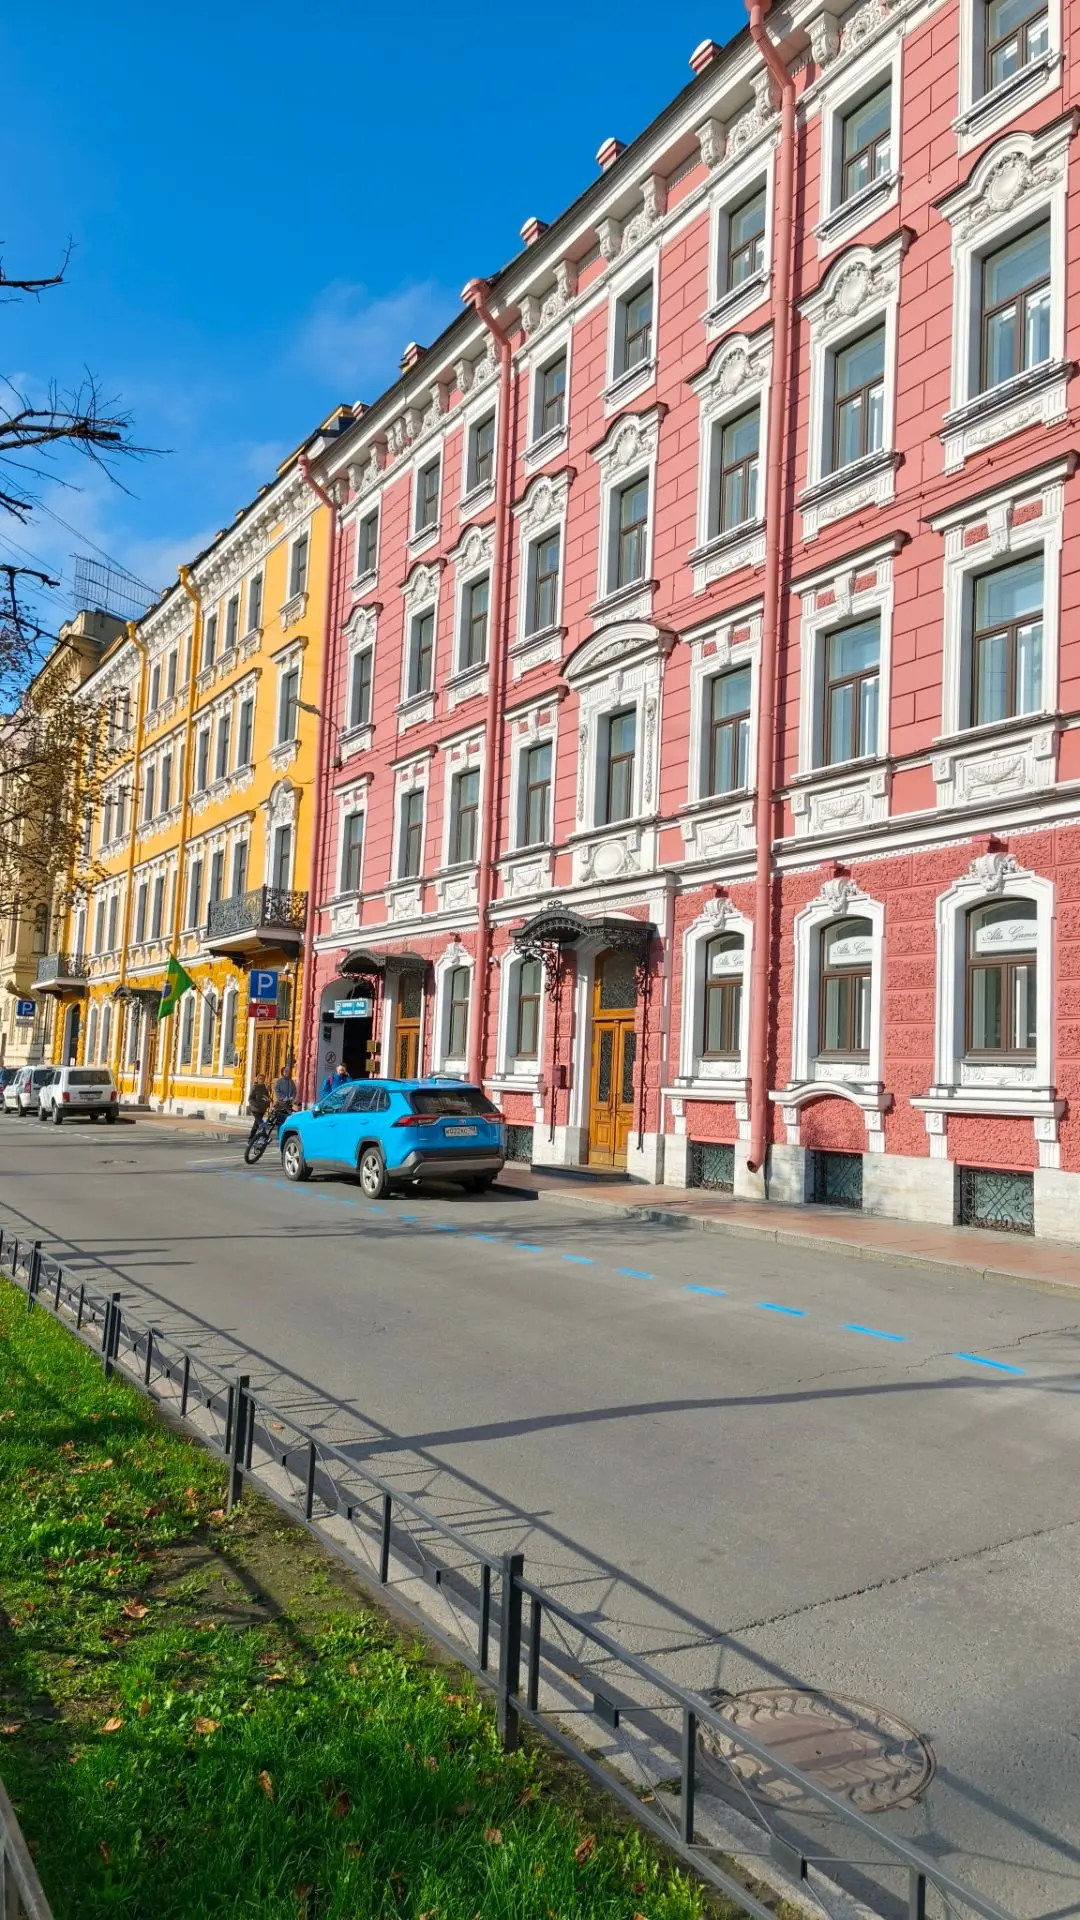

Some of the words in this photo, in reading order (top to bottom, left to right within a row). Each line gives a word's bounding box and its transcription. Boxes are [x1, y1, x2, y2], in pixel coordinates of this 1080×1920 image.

[1008, 926, 1037, 942] Gamm
[257, 973, 274, 996] P
[22, 1002, 33, 1015] P
